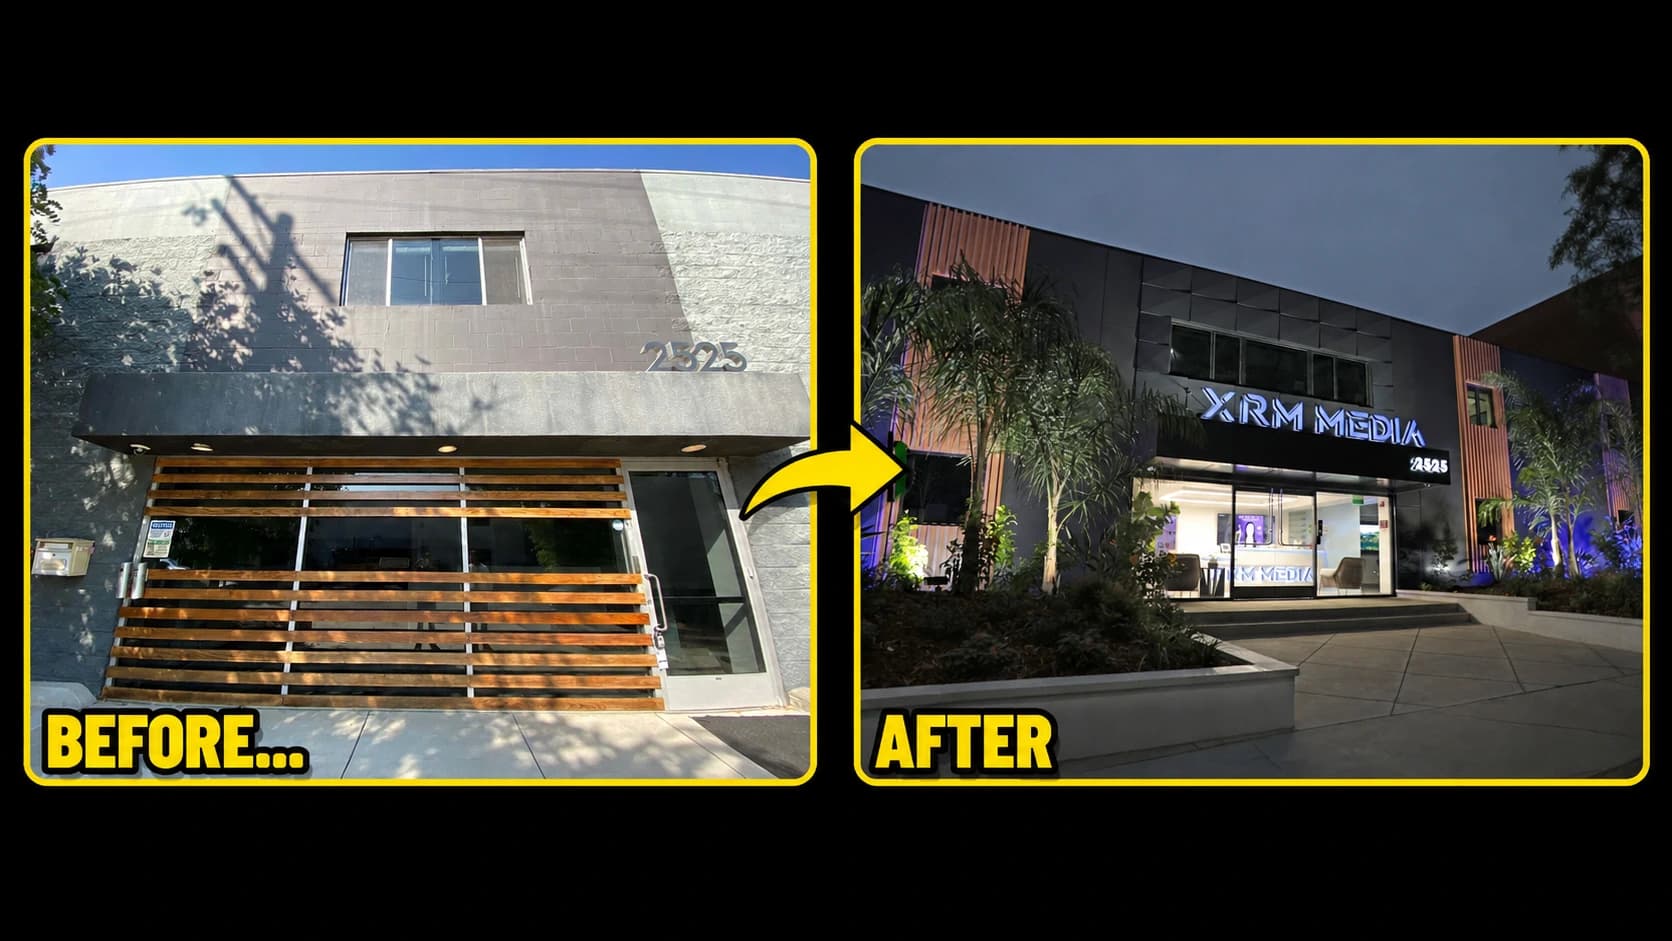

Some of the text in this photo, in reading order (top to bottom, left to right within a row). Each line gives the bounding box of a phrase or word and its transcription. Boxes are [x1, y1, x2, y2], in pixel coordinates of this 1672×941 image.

[640, 341, 747, 372] 2525
[1201, 387, 1426, 448] XRM MEDIA
[1410, 456, 1448, 473] 2525
[1260, 566, 1313, 583] MEDIA
